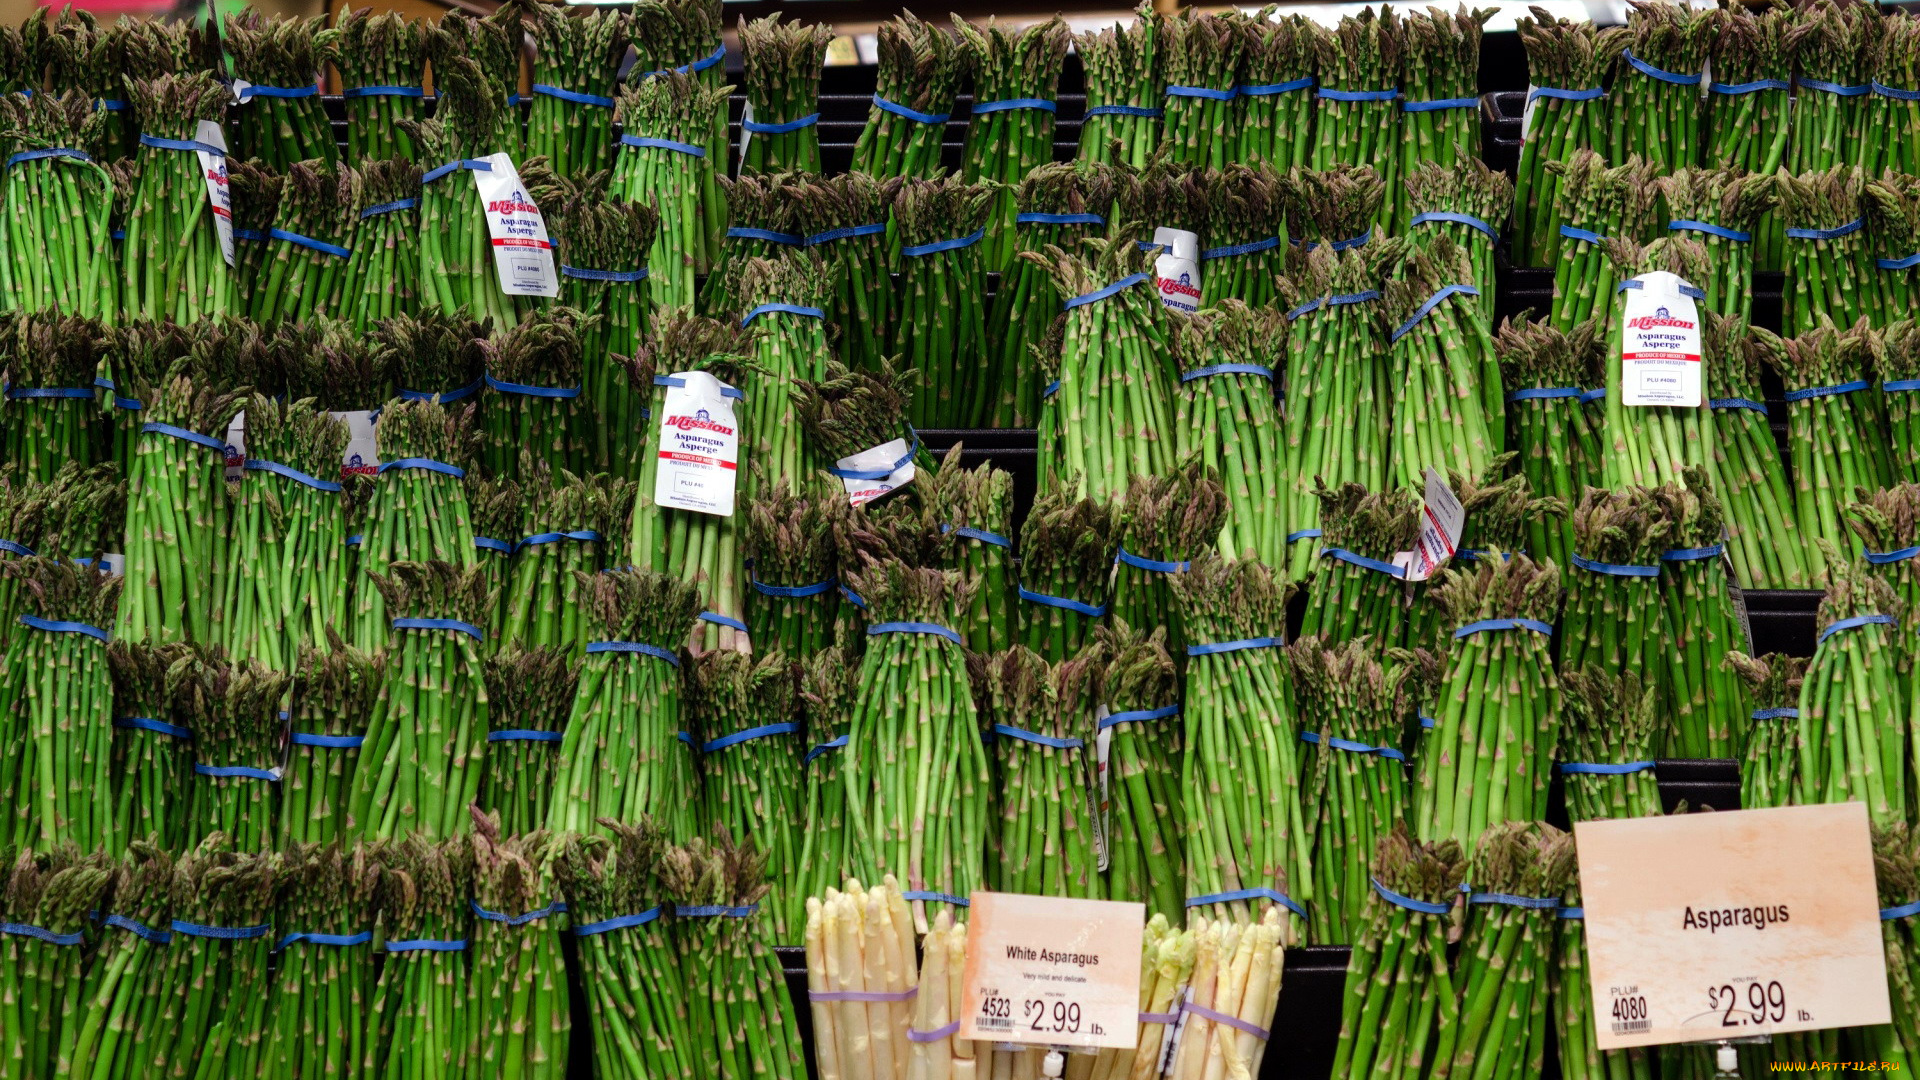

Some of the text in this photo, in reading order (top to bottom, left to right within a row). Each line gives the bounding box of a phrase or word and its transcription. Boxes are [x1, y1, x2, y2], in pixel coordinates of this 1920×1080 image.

[488, 200, 539, 215] Mission
[501, 218, 538, 227] Asparagus
[507, 227, 537, 236] Asperge
[1627, 316, 1694, 331] Mission
[1637, 333, 1687, 342] Asparagus
[1642, 341, 1681, 350] Asperge
[665, 414, 734, 436] Mission
[674, 432, 725, 447] Asparagus
[679, 441, 718, 455] Asperge
[1683, 904, 1790, 934] Asparagus
[1006, 945, 1099, 967] White Asparagus
[1023, 972, 1087, 983] Very mild and delicate
[980, 987, 999, 997] PLU#
[1611, 986, 1639, 996] PLU#
[982, 997, 1011, 1018] 4523
[1612, 996, 1647, 1021] 4080
[1709, 980, 1814, 1027] $2.99 lb.
[1024, 999, 1107, 1036] $2.99 lb.
